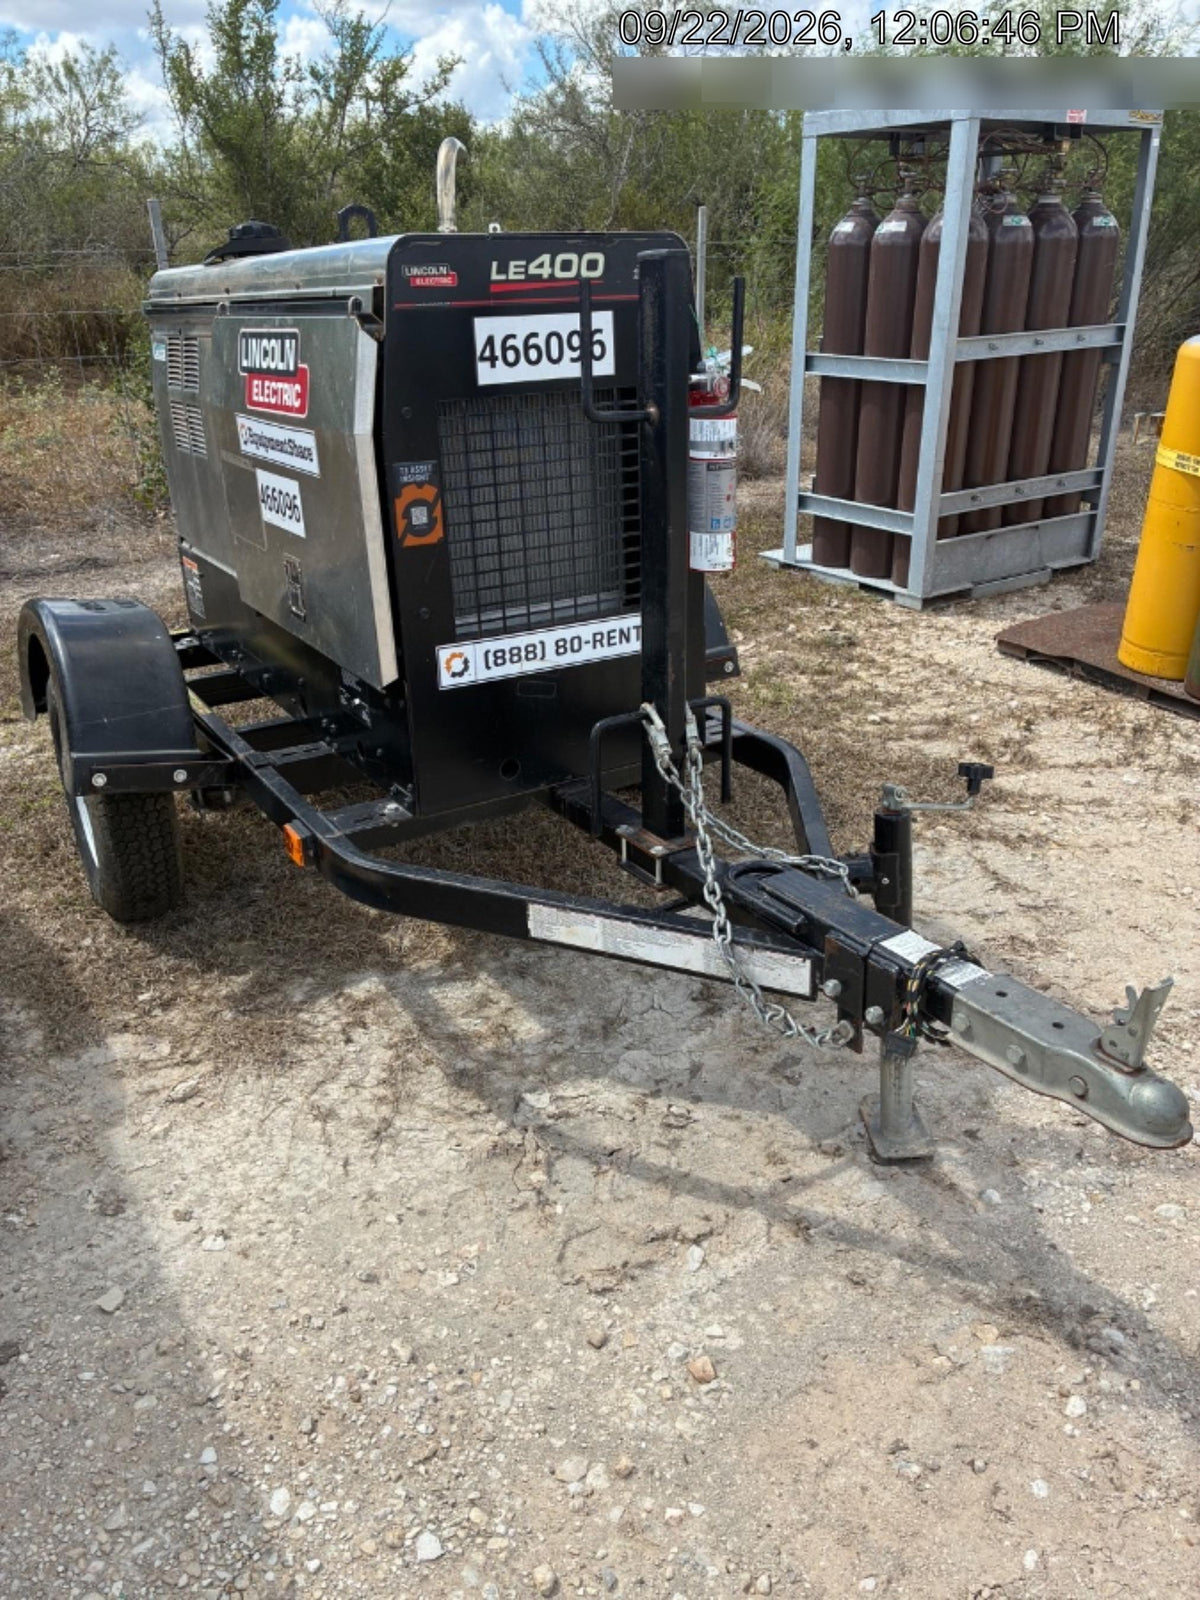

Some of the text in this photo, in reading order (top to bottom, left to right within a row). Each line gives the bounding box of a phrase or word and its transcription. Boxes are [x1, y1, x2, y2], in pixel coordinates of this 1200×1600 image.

[405, 265, 447, 276] LINCOLN
[490, 252, 605, 280] LE400
[241, 337, 296, 371] LINCOLN
[478, 328, 607, 369] 466096
[252, 379, 301, 408] ELECTRIC
[246, 426, 314, 462] EquipmentShare
[260, 483, 301, 523] 466096
[484, 640, 546, 670] (888)
